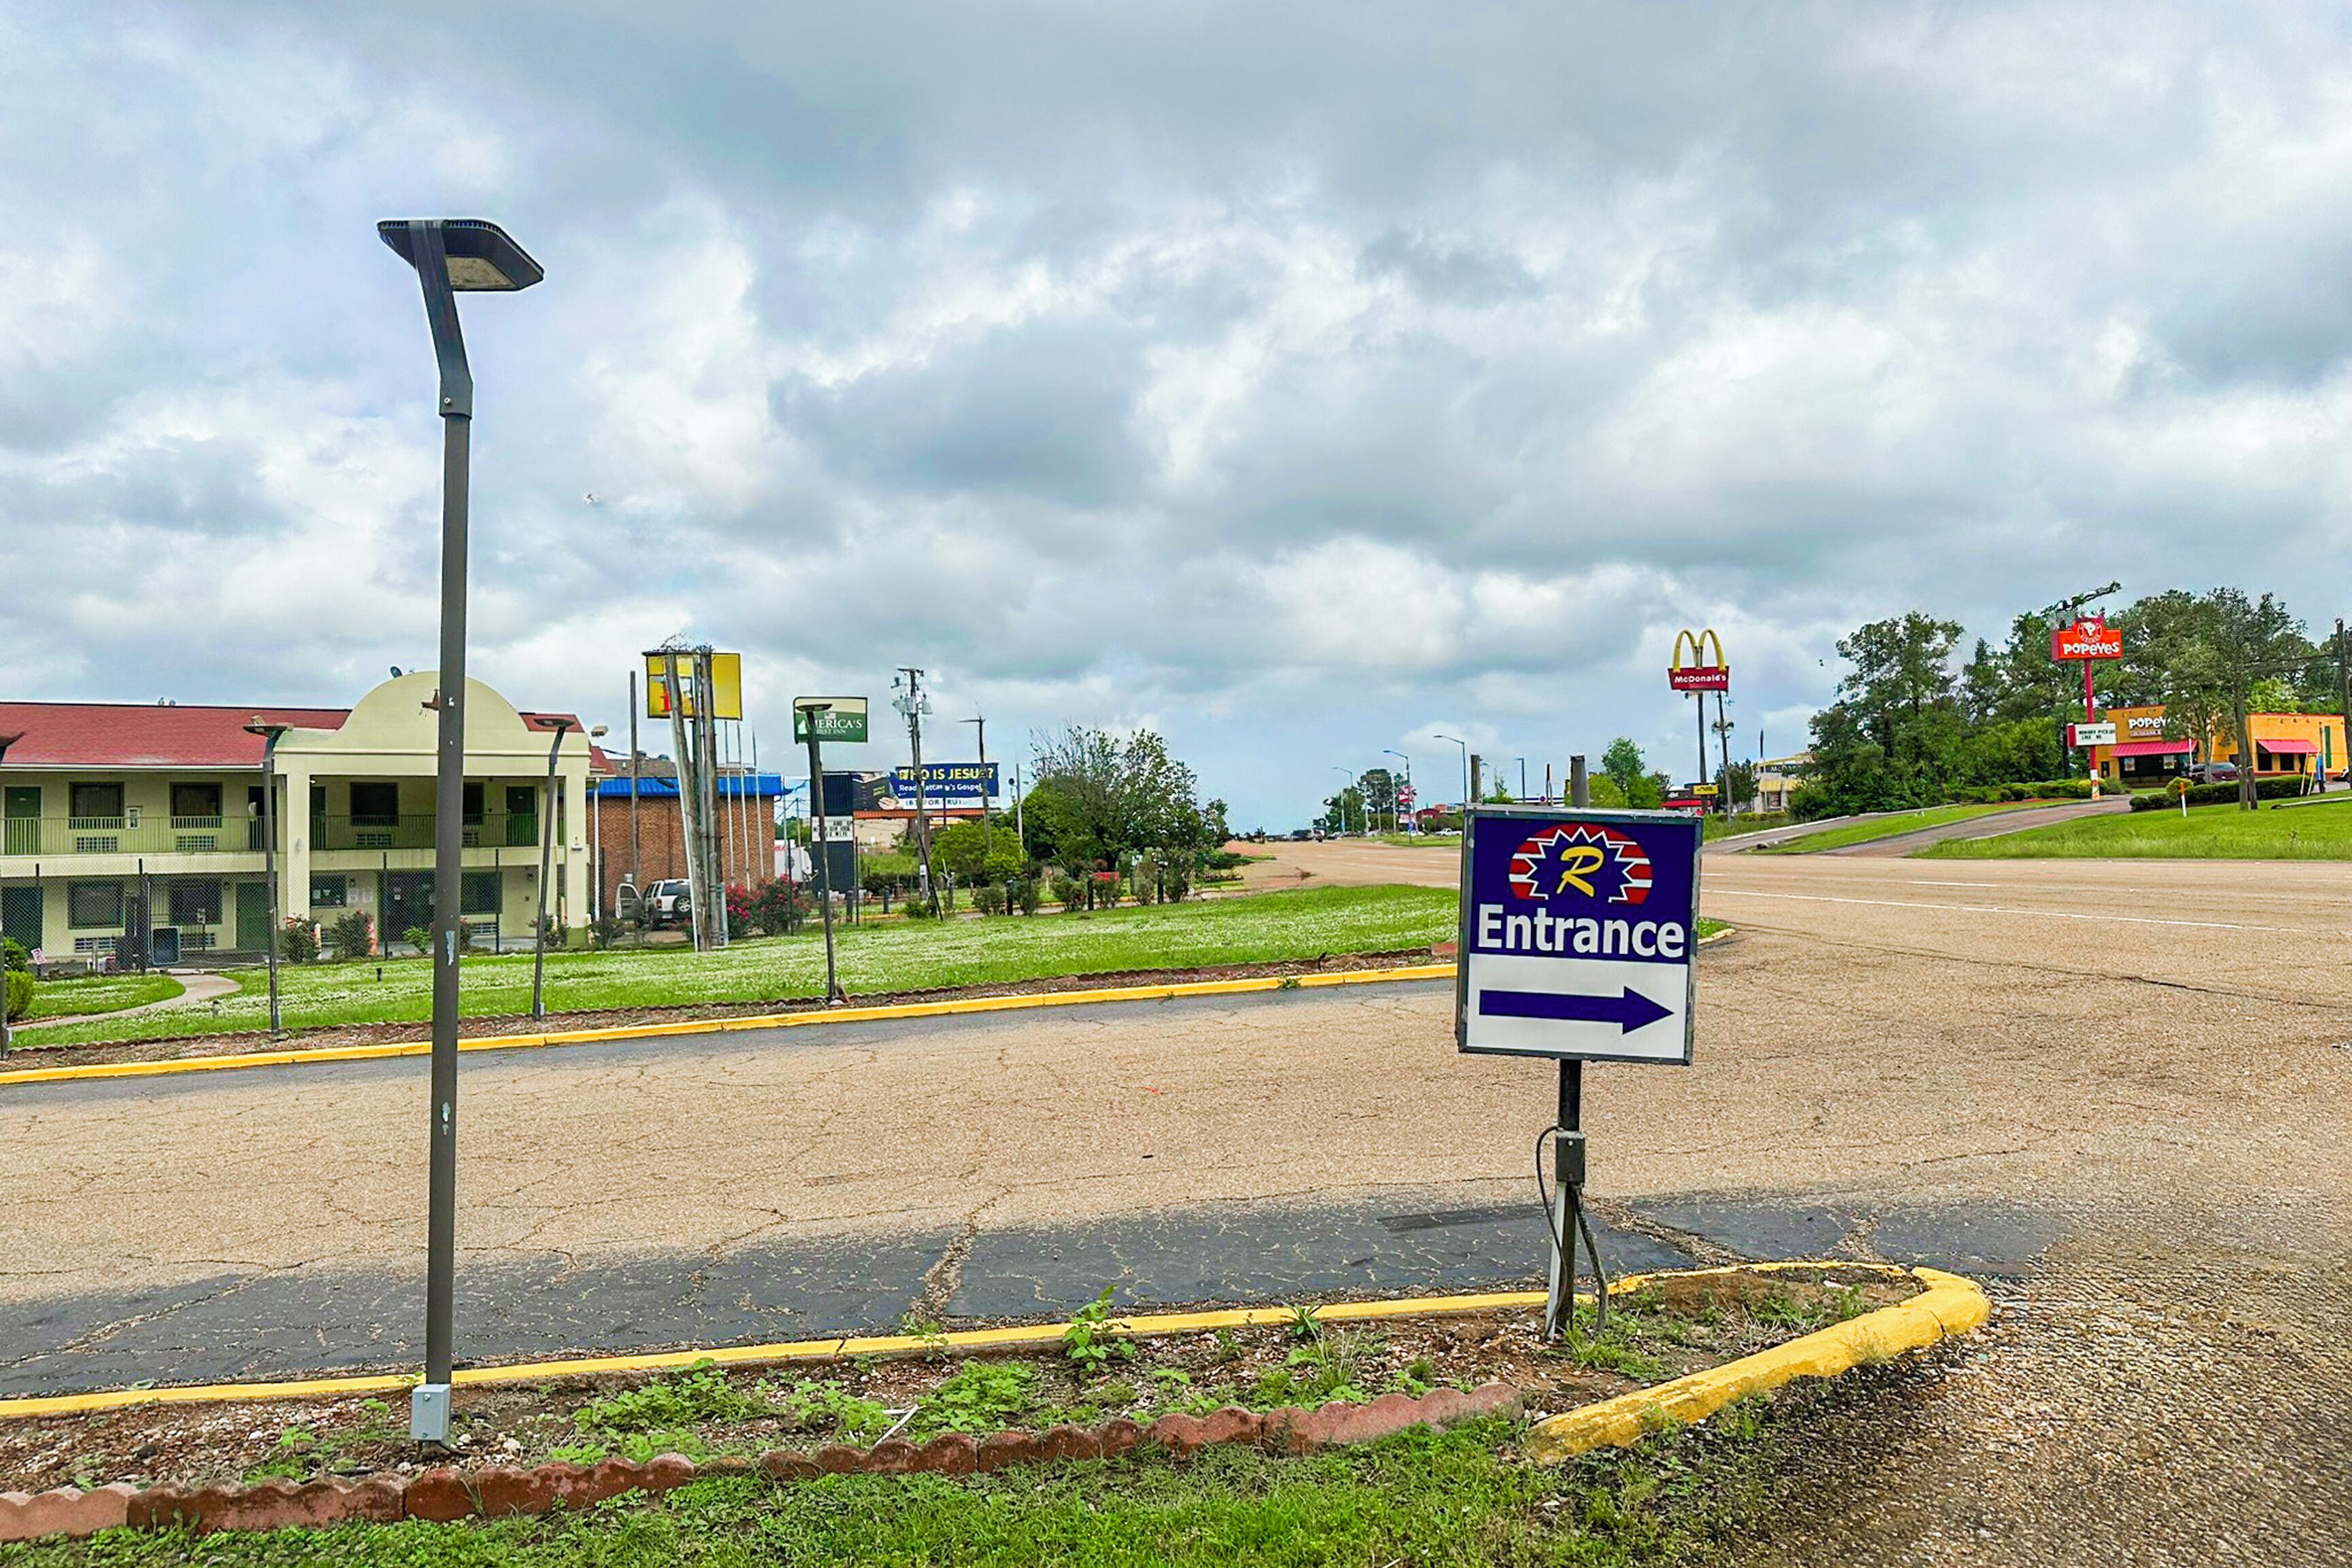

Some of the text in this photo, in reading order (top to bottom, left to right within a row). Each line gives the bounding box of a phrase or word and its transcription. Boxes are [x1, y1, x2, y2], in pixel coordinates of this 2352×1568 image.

[1674, 674, 1727, 683] McDonald's
[933, 768, 946, 780] IS
[1556, 846, 1605, 898] R
[1477, 904, 1685, 958] Entrance
